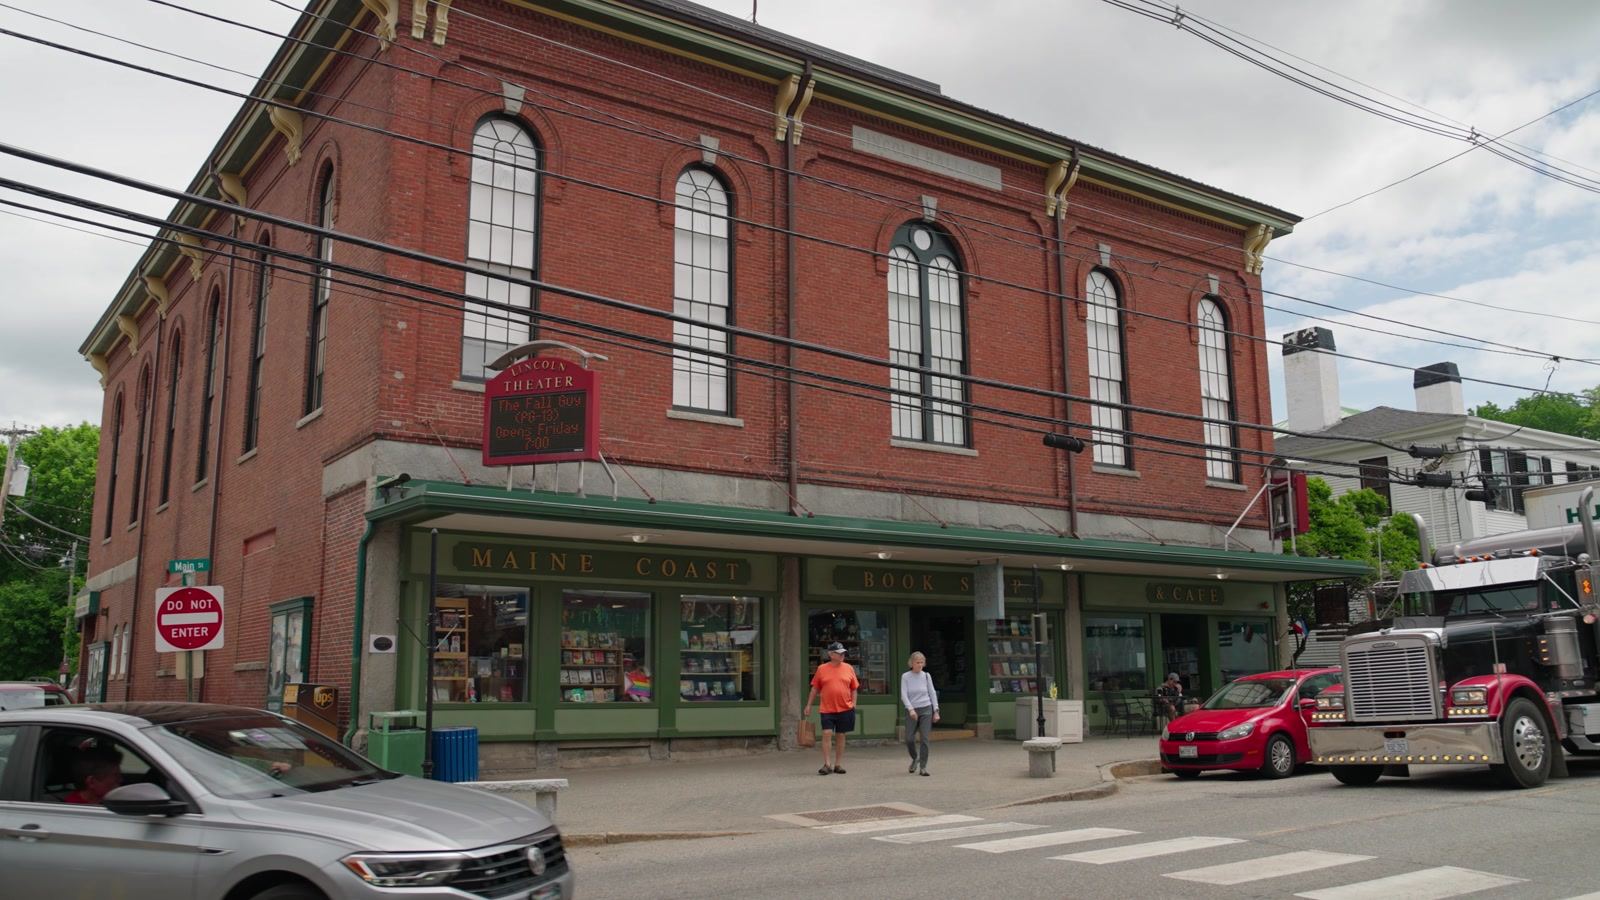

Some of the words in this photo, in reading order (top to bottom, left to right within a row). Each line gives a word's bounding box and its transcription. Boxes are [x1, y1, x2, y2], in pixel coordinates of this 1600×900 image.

[511, 360, 567, 377] LINCOLN
[504, 376, 573, 391] THEATER
[498, 400, 519, 411] The
[526, 397, 551, 409] Fall
[558, 395, 580, 408] Guy
[495, 426, 532, 439] Opens
[538, 422, 579, 436] Friday
[525, 436, 549, 450] 7:00
[175, 562, 195, 572] Main
[472, 547, 593, 573] MAINE
[636, 557, 738, 580] COAST
[864, 571, 934, 591] BOOK
[167, 601, 183, 611] DO
[190, 599, 213, 610] NOT
[171, 627, 208, 638] ENTER
